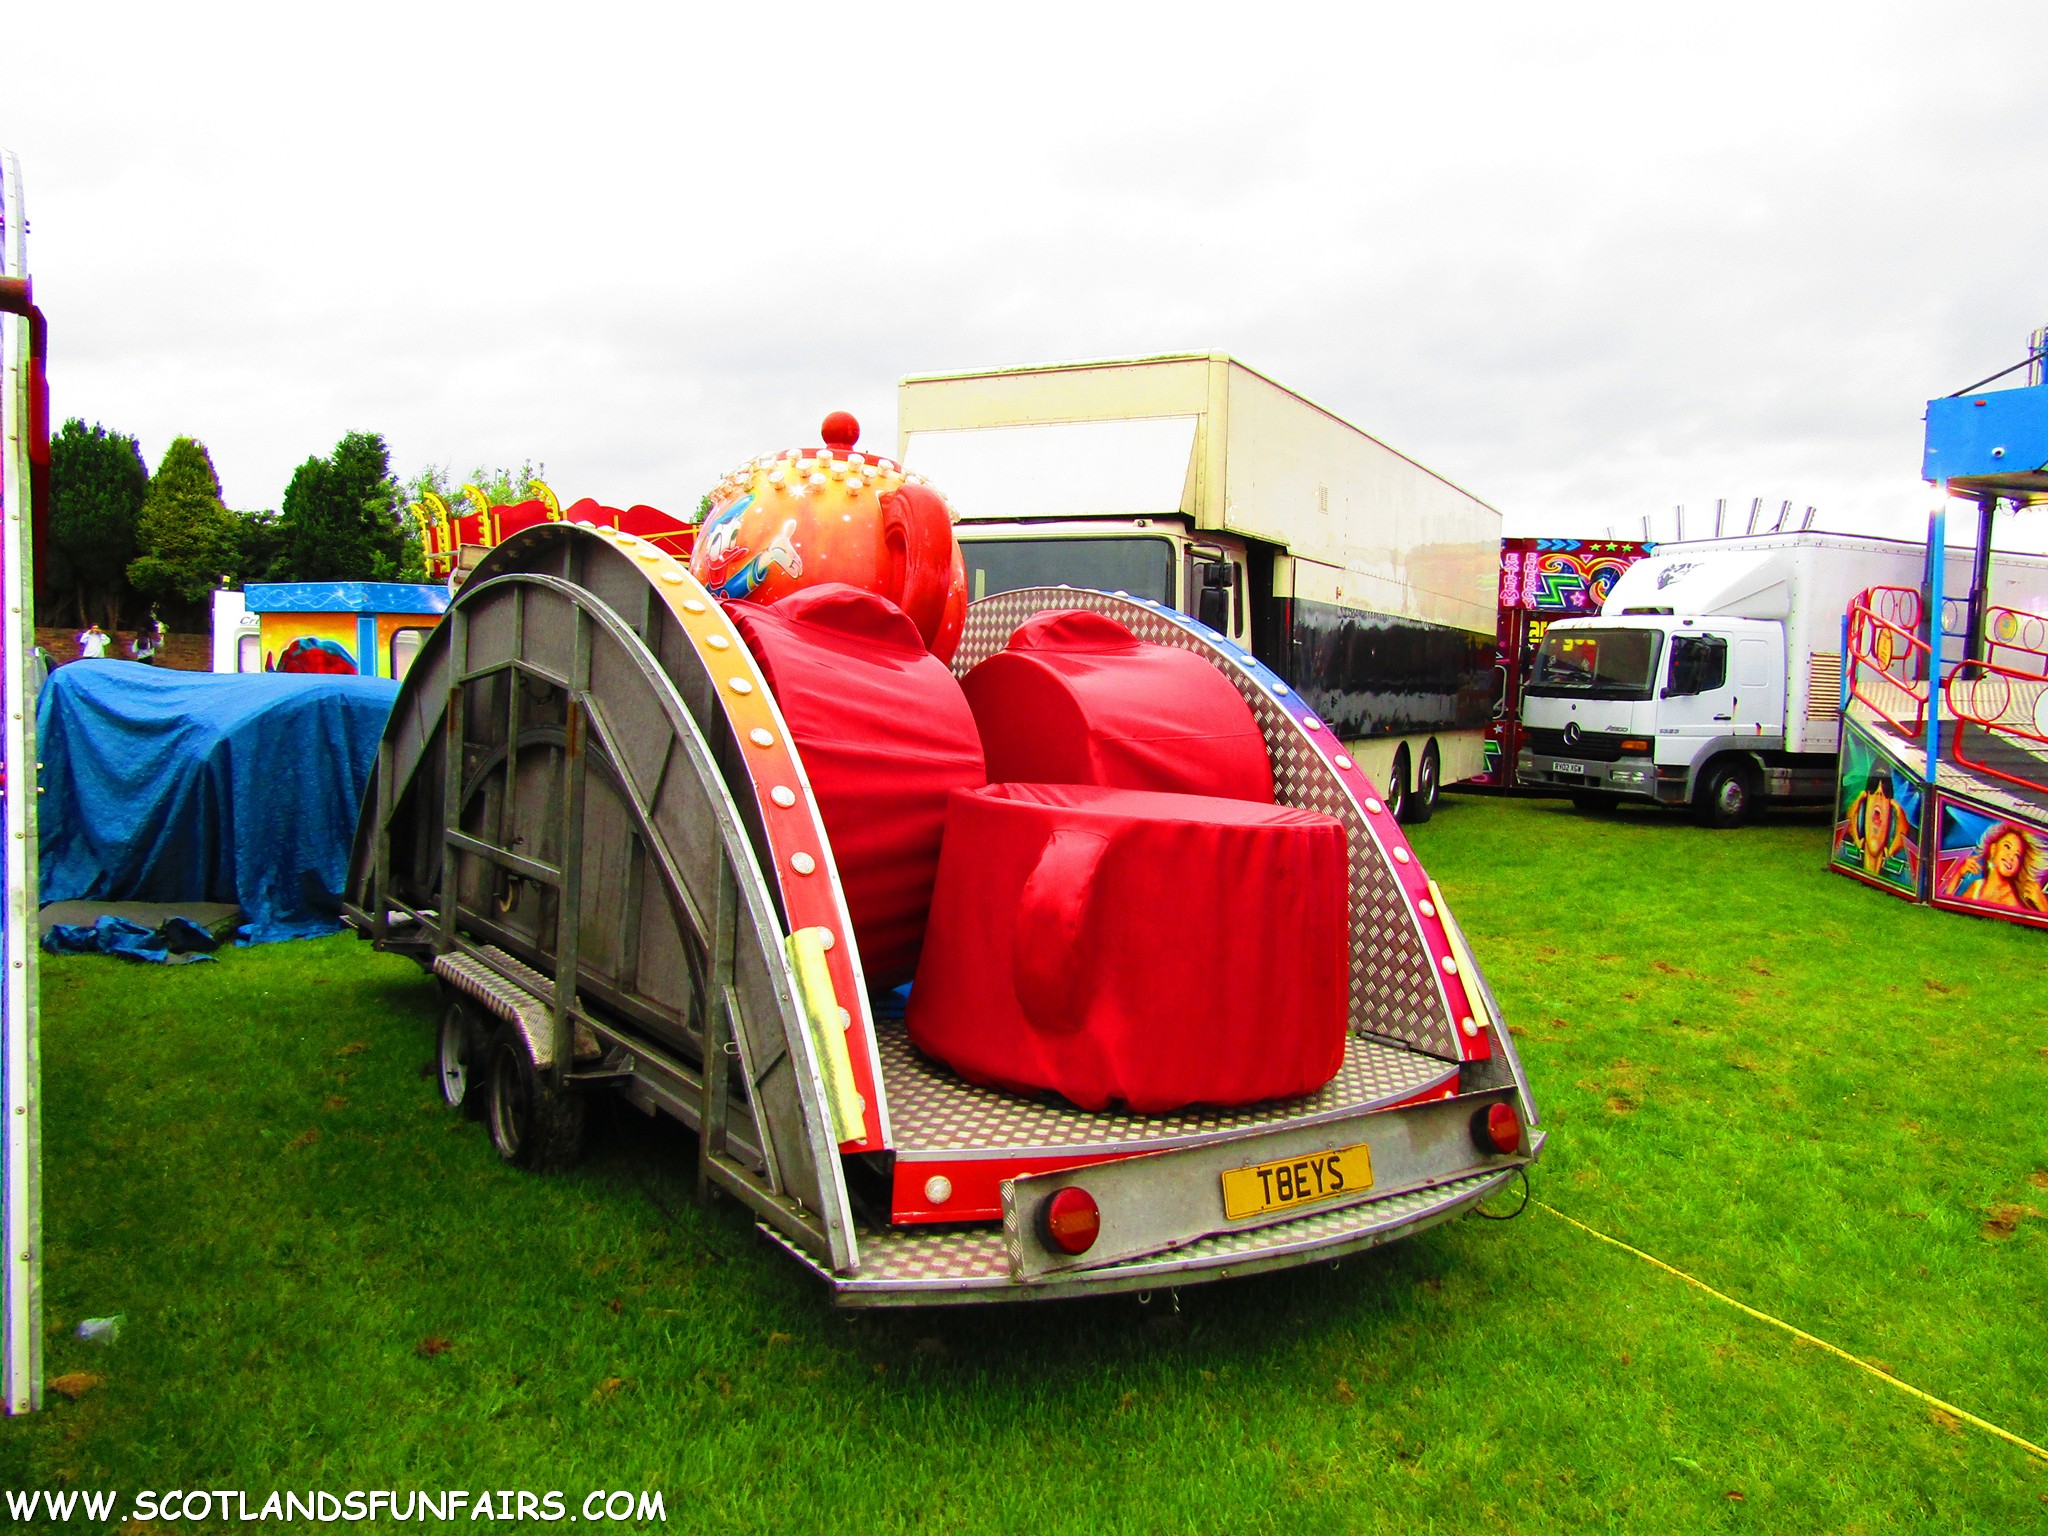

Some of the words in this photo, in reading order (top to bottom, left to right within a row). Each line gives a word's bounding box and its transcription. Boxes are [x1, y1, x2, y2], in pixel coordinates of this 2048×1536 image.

[1501, 553, 1520, 607] EXTREME
[1522, 552, 1538, 609] ENERGY
[1257, 1155, 1344, 1204] T8EYS
